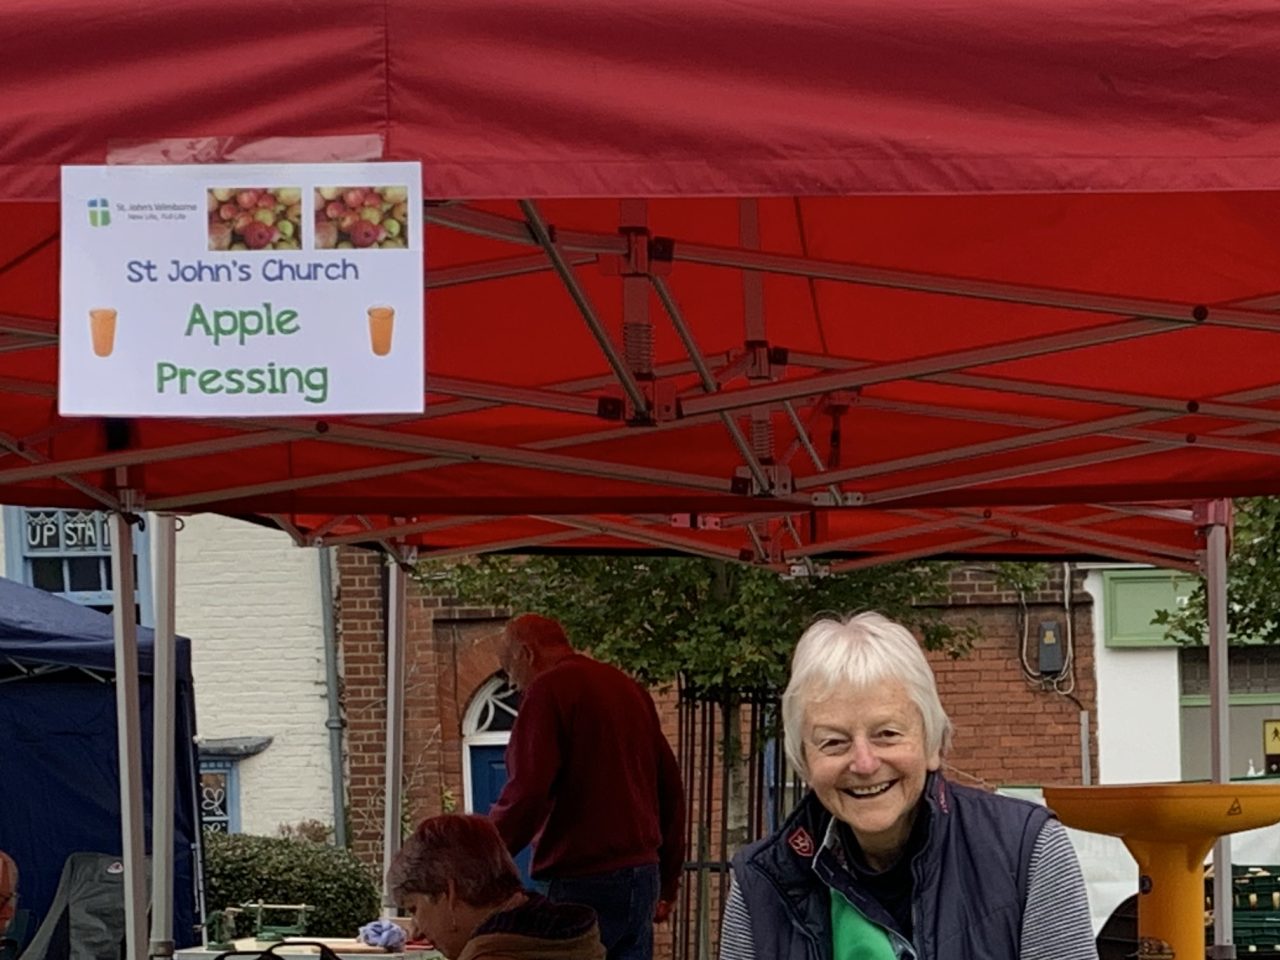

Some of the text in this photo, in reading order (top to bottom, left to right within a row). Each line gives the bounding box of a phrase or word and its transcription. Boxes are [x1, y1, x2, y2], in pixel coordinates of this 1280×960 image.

[127, 258, 360, 283] St John's Church
[184, 302, 300, 345] Apple
[156, 362, 328, 403] Pressing
[27, 522, 57, 546] UP
